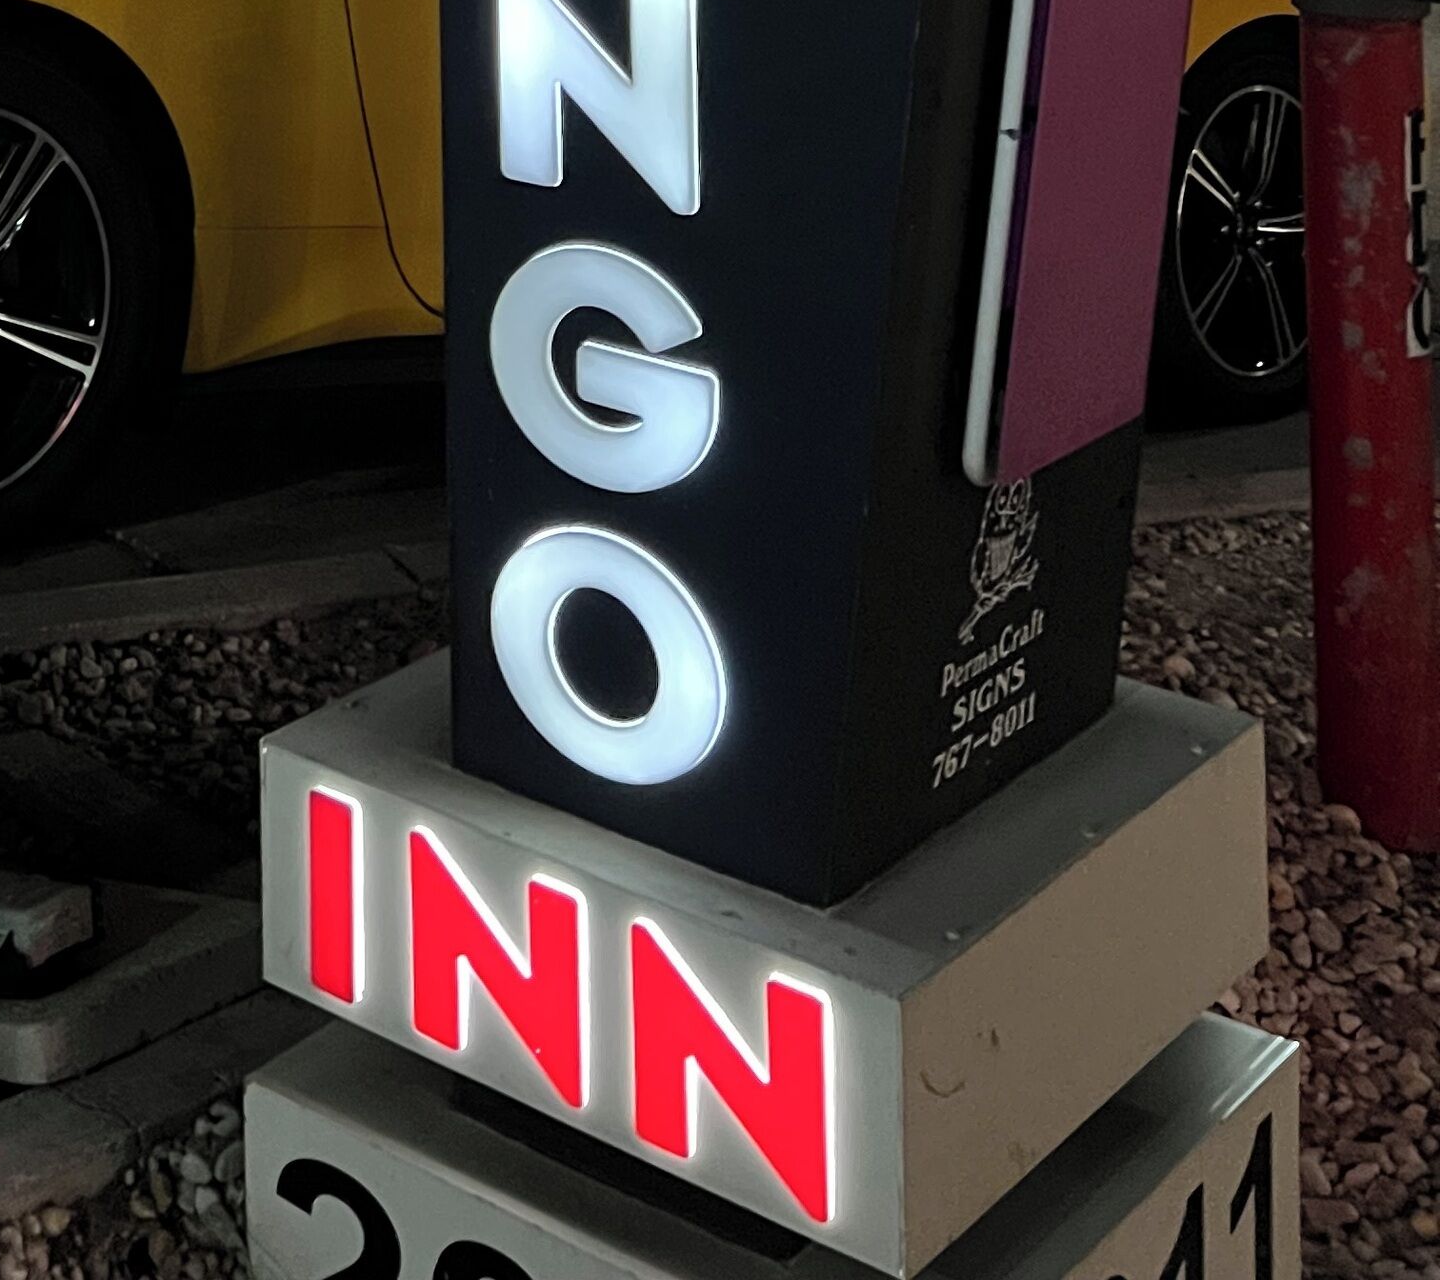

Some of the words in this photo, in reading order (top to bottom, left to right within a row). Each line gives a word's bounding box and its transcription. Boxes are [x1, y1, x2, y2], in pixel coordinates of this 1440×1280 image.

[940, 609, 1045, 697] PermaCraft
[951, 657, 1026, 732] SIGNS
[932, 691, 1036, 789] 767-8011
[309, 783, 835, 1224] INN
